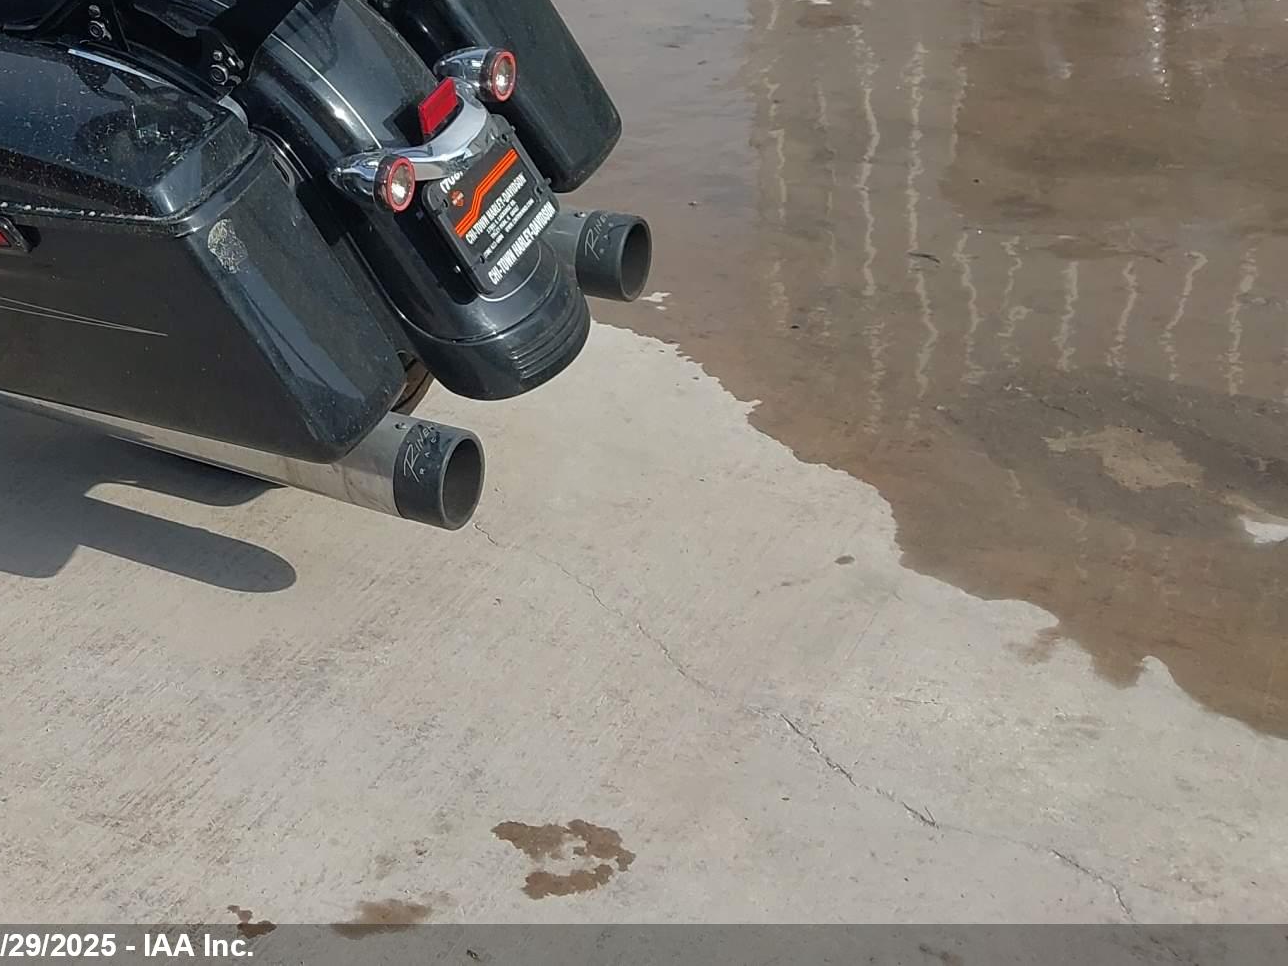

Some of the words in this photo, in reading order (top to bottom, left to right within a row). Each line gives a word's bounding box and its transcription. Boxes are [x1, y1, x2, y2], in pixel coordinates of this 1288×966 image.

[465, 213, 490, 244] CHI-TOWN
[484, 172, 526, 221] HARLEY-DAVIDSON
[487, 248, 517, 285] CHI-TOWN
[510, 201, 555, 257] HARLEY-DAVIDSON
